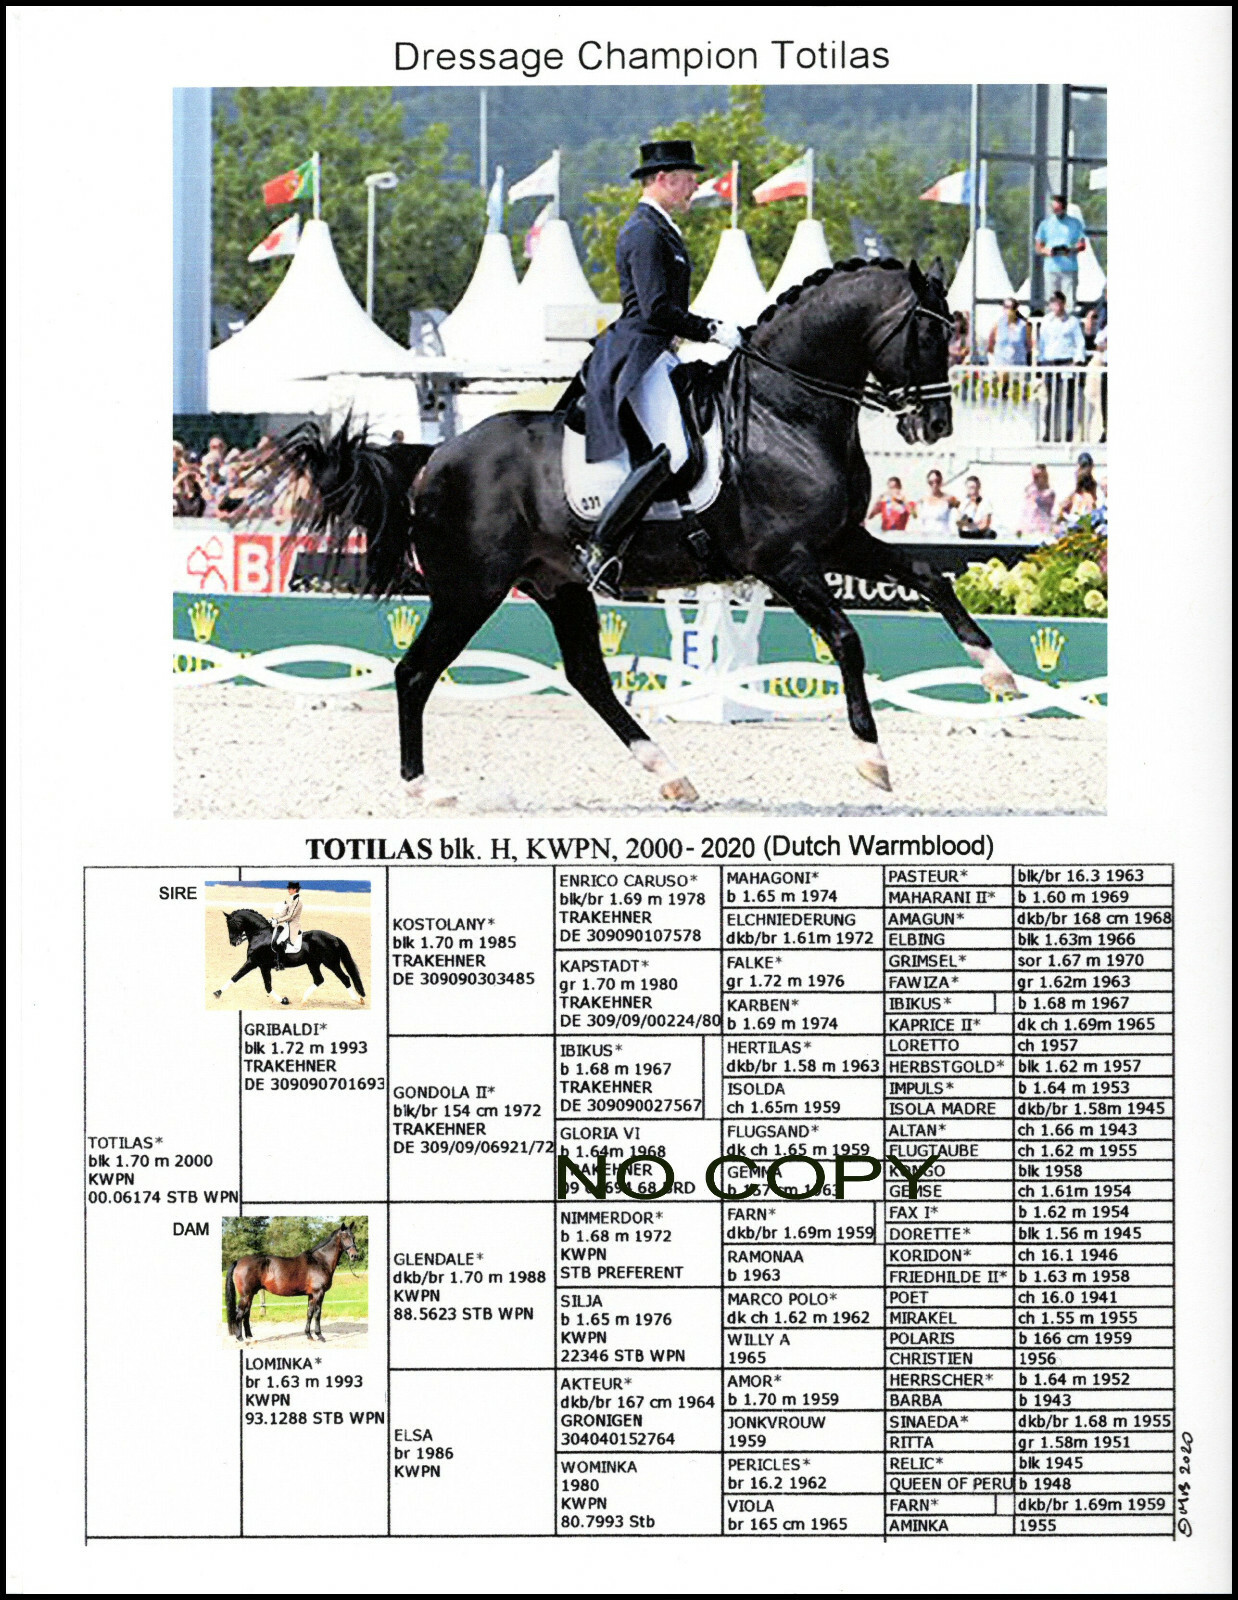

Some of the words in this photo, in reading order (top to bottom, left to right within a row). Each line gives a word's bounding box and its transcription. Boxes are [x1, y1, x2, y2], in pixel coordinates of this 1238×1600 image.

[395, 41, 564, 78] Dressage
[578, 40, 757, 77] Champion
[771, 40, 890, 70] Totilas
[683, 630, 699, 669] E
[305, 837, 433, 861] TOTILAS
[439, 837, 482, 860] blk.
[490, 838, 518, 863] H,
[526, 837, 618, 863] KWPN,
[700, 837, 756, 859] 2020
[763, 834, 841, 862] (Dutch
[848, 834, 994, 861] Warmblood)
[1018, 868, 1062, 885] blk/br
[1067, 868, 1100, 883] 16.3
[1106, 868, 1144, 882] 1963
[159, 886, 198, 900] SIRE
[558, 910, 653, 924] TRAKEHNER
[727, 912, 856, 927] ELCHNIEDERUNG
[1016, 911, 1068, 927] dkb/br
[1073, 911, 1101, 925] 168
[1106, 914, 1129, 925] cm
[1134, 911, 1172, 925] 1968
[392, 935, 415, 950] blk
[421, 935, 454, 949] 1.70
[458, 938, 473, 949] m
[479, 935, 517, 949] 1985
[560, 928, 581, 942] DE
[586, 928, 702, 943] 309090107578
[888, 932, 945, 946] ELBING
[392, 953, 486, 968] TRAKEHNER
[393, 972, 414, 986] DE
[420, 971, 535, 986] 309090303485
[558, 995, 653, 1009] TRAKEHNER
[244, 1041, 266, 1055] blk
[271, 1041, 304, 1055] 1.72
[309, 1043, 324, 1054] m
[330, 1040, 368, 1055] 1993
[889, 1038, 960, 1052] LORETTO
[1017, 1038, 1035, 1052] ch
[1041, 1038, 1079, 1052] 1957
[243, 1058, 337, 1073] TRAKEHNER
[244, 1077, 265, 1091] DE
[270, 1077, 385, 1091] 309090701693
[559, 1080, 653, 1094] TRAKEHNER
[727, 1082, 786, 1096] ISOLDA
[393, 1085, 470, 1100] GONDOLA
[393, 1103, 438, 1120] blk/br
[444, 1104, 471, 1118] 154
[476, 1106, 498, 1118] cm
[504, 1103, 542, 1118] 1972
[560, 1098, 581, 1112] DE
[587, 1098, 702, 1113] 309090027567
[889, 1102, 936, 1116] ISOLA
[941, 1101, 996, 1116] MADRE
[392, 1122, 487, 1136] TRAKEHNER
[560, 1126, 619, 1140] GLORIA
[623, 1126, 640, 1140] VI
[393, 1140, 415, 1154] DE
[420, 1140, 554, 1156] 309/09/06921/72
[889, 1144, 979, 1158] FLUGTAUBE
[88, 1153, 111, 1168] blk
[116, 1154, 150, 1168] 1.70
[154, 1157, 170, 1168] m
[174, 1154, 213, 1168] 2000
[1018, 1163, 1040, 1178] blk
[1045, 1164, 1083, 1178] 1958
[88, 1172, 135, 1186] KWPN
[88, 1190, 161, 1204] 00.06174
[166, 1190, 198, 1204] STB
[203, 1190, 239, 1204] WPN
[173, 1222, 210, 1236] DAM
[560, 1247, 607, 1261] KWPN
[727, 1250, 804, 1264] RAMONAA
[1017, 1247, 1035, 1262] ch
[1041, 1248, 1074, 1262] 16.1
[1081, 1247, 1118, 1262] 1946
[392, 1270, 445, 1286] dkb/br
[450, 1270, 483, 1284] 1.70
[488, 1273, 503, 1284] m
[509, 1270, 547, 1284] 1988
[560, 1265, 592, 1279] STB
[597, 1265, 684, 1279] PREFERENT
[393, 1289, 440, 1303] KWPN
[560, 1294, 603, 1308] SILJA
[889, 1290, 929, 1304] POET
[393, 1307, 457, 1321] 88.5623
[462, 1306, 493, 1321] STB
[497, 1306, 534, 1321] WPN
[889, 1311, 957, 1325] MIRAKEL
[560, 1331, 607, 1345] KWPN
[727, 1333, 775, 1346] WILLY
[779, 1333, 791, 1346] A
[889, 1331, 955, 1345] POLARIS
[560, 1349, 609, 1363] 22346
[614, 1348, 645, 1363] STB
[649, 1348, 686, 1363] WPN
[729, 1351, 766, 1365] 1965
[889, 1351, 973, 1366] CHRISTIEN
[1020, 1351, 1057, 1366] 1956
[245, 1375, 261, 1389] br
[267, 1375, 300, 1389] 1.63
[305, 1377, 320, 1388] m
[326, 1374, 363, 1388] 1993
[245, 1393, 291, 1407] KWPN
[890, 1393, 943, 1407] BARBA
[1019, 1393, 1028, 1407] b
[1034, 1393, 1072, 1407] 1943
[245, 1411, 308, 1425] 93.1288
[312, 1411, 344, 1425] STB
[349, 1411, 385, 1425] WPN
[560, 1413, 643, 1428] GRONIGEN
[727, 1416, 826, 1430] JONKVROUW
[394, 1428, 433, 1442] ELSA
[561, 1432, 676, 1446] 304040152764
[729, 1434, 767, 1448] 1959
[889, 1435, 934, 1449] RITTA
[394, 1446, 411, 1460] br
[417, 1446, 454, 1460] 1986
[1179, 1431, 1194, 1475] 2020
[560, 1460, 638, 1474] WOMINKA
[1018, 1455, 1041, 1470] blk
[1046, 1456, 1083, 1470] 1945
[394, 1464, 441, 1478] KWPN
[562, 1478, 600, 1492] 1980
[889, 1477, 942, 1492] QUEEN
[947, 1476, 969, 1490] OF
[972, 1477, 1013, 1491] PERU
[1019, 1476, 1028, 1491] b
[1034, 1477, 1072, 1491] 1948
[561, 1496, 607, 1510] KWPN
[727, 1499, 775, 1513] VIOLA
[560, 1514, 624, 1528] 80.7993
[629, 1514, 656, 1528] Stb
[889, 1518, 949, 1533] AMINKA
[1020, 1518, 1057, 1532] 1955
